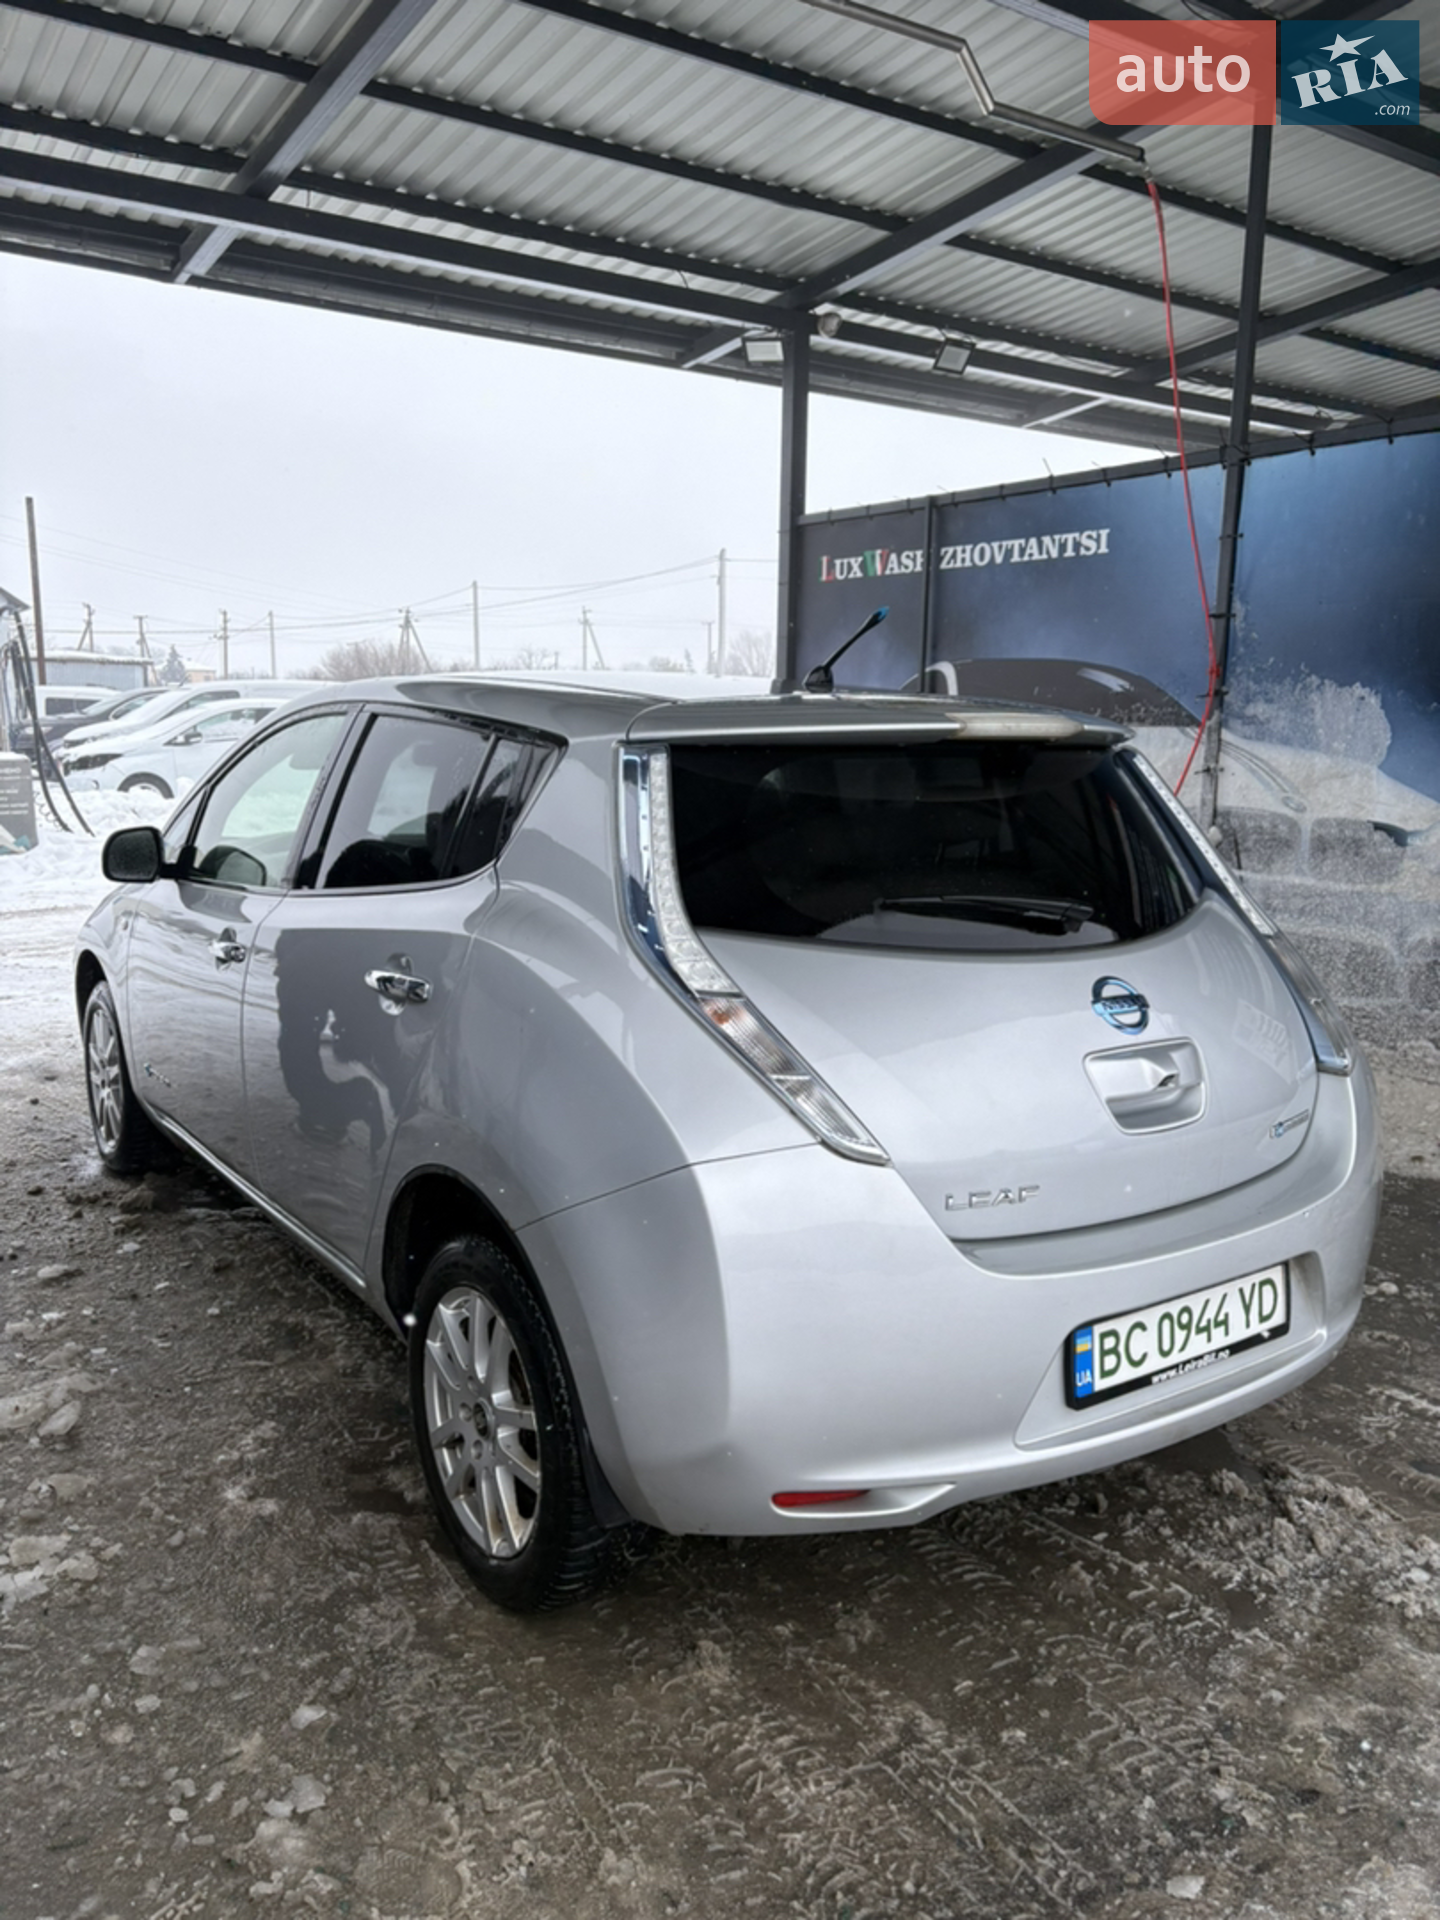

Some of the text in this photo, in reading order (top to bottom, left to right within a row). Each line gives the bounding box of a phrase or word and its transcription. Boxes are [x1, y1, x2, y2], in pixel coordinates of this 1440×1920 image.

[940, 528, 1110, 569] ZHOVTANTSI
[945, 1185, 1040, 1211] LEAF
[1099, 1277, 1278, 1379] BC 0944 YD
[1076, 1368, 1093, 1387] UA
